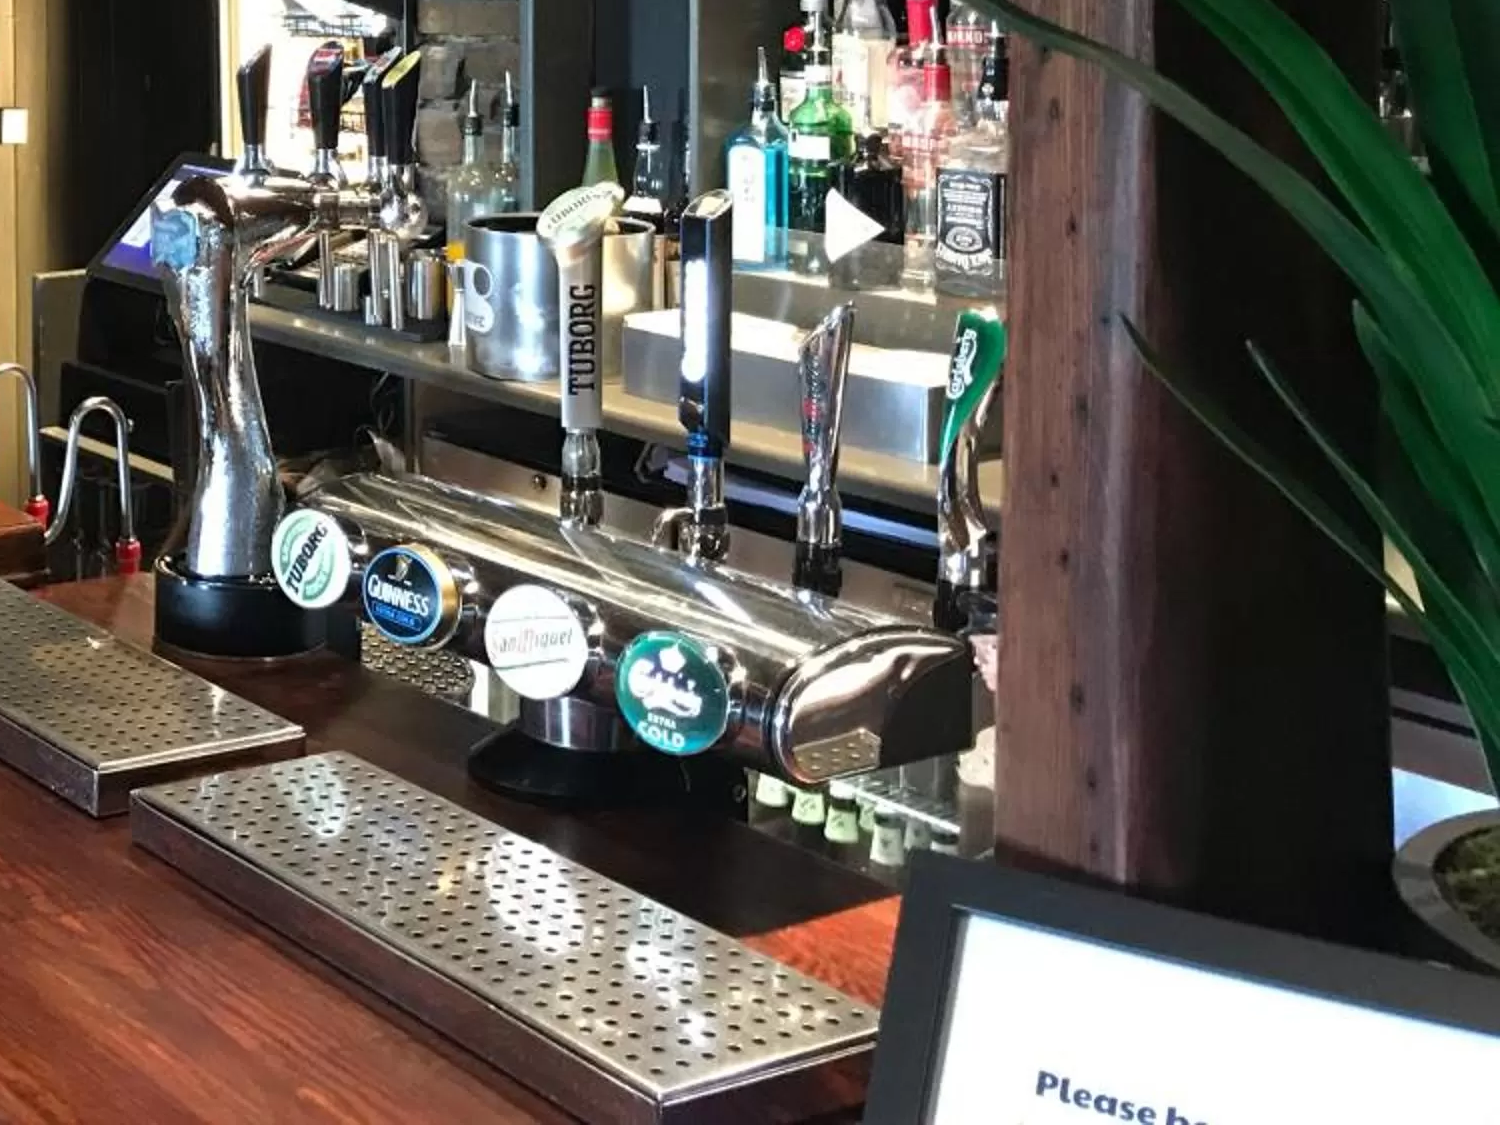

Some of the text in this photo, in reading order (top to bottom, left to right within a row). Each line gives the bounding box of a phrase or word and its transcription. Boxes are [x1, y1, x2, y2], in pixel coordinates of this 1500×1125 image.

[568, 283, 596, 396] TUBORG
[946, 328, 978, 399] Carlsberg
[286, 521, 329, 595] TUBORG
[367, 574, 430, 617] GUINNESS
[637, 720, 686, 749] COLD
[1035, 1070, 1157, 1125] Please
